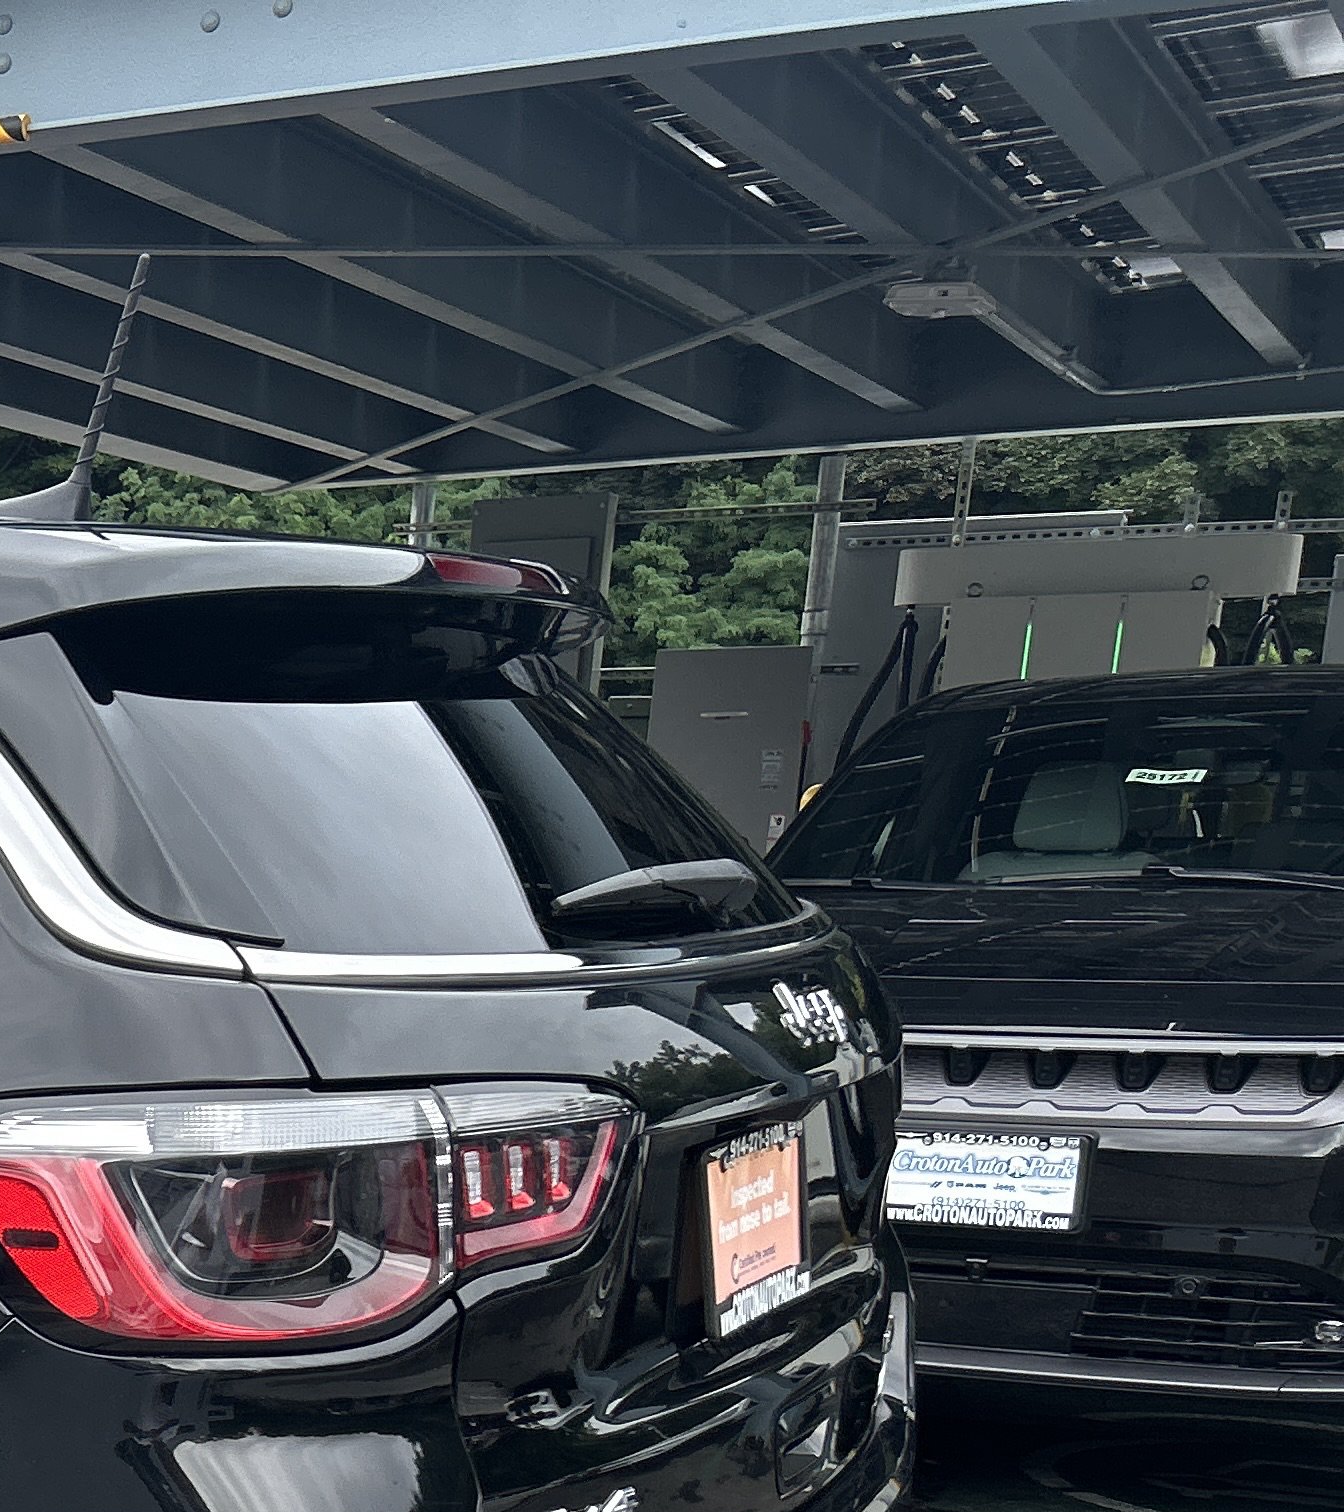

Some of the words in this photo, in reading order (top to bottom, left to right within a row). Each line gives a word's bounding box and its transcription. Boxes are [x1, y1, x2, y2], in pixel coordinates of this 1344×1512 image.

[932, 1132, 1039, 1147] 914-271-5100
[718, 1219, 739, 1244] from
[739, 1209, 760, 1234] nose
[761, 1202, 772, 1224] to
